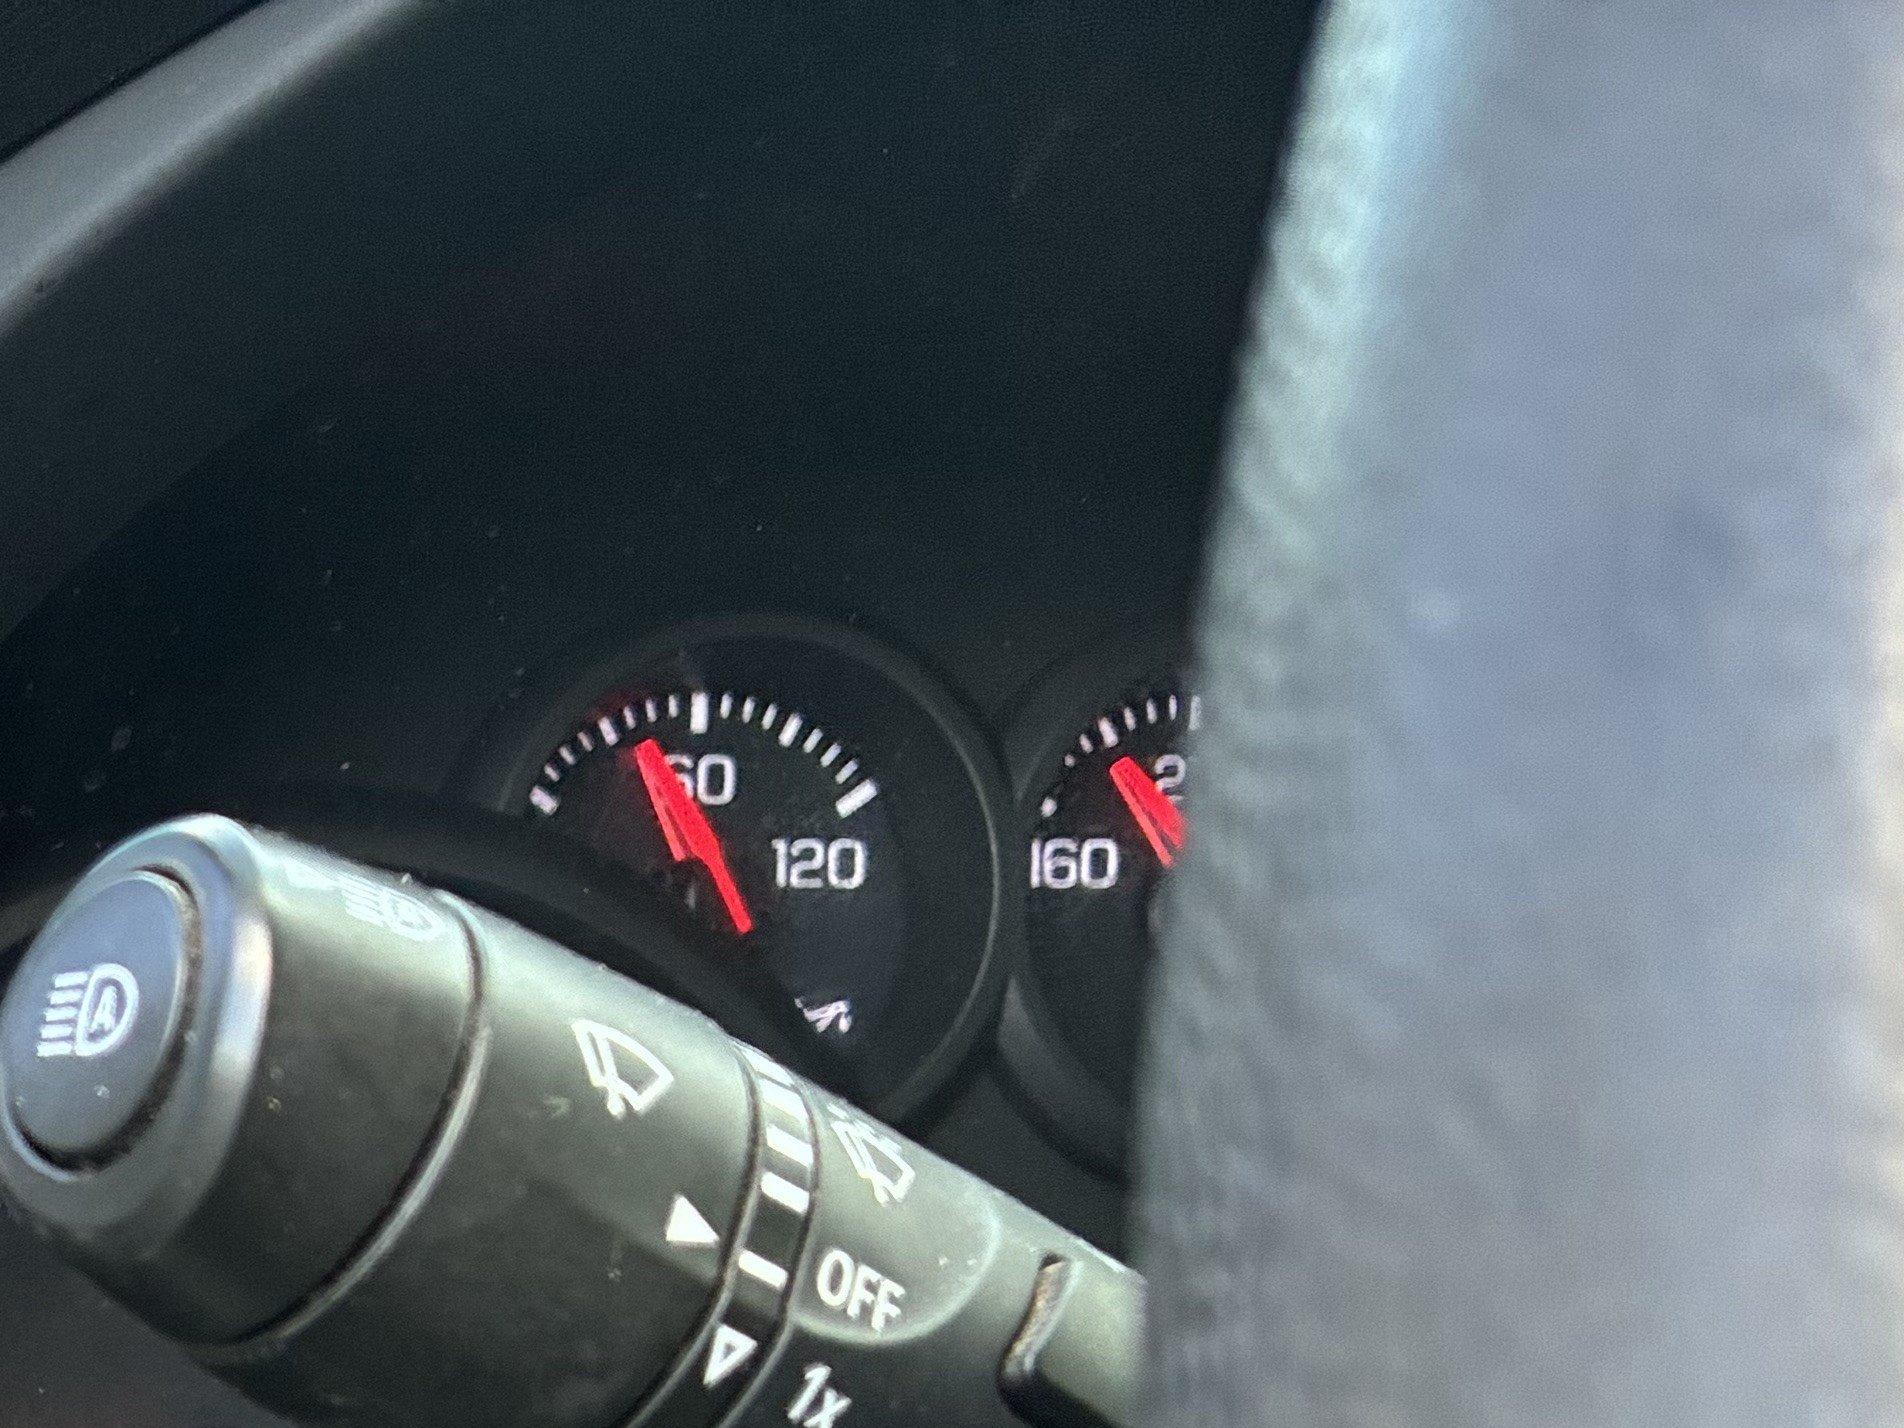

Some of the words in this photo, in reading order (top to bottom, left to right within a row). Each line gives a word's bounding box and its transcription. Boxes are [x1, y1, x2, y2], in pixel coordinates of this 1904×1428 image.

[771, 837, 867, 890] 120
[1030, 838, 1119, 890] 160
[816, 1249, 906, 1332] OFF
